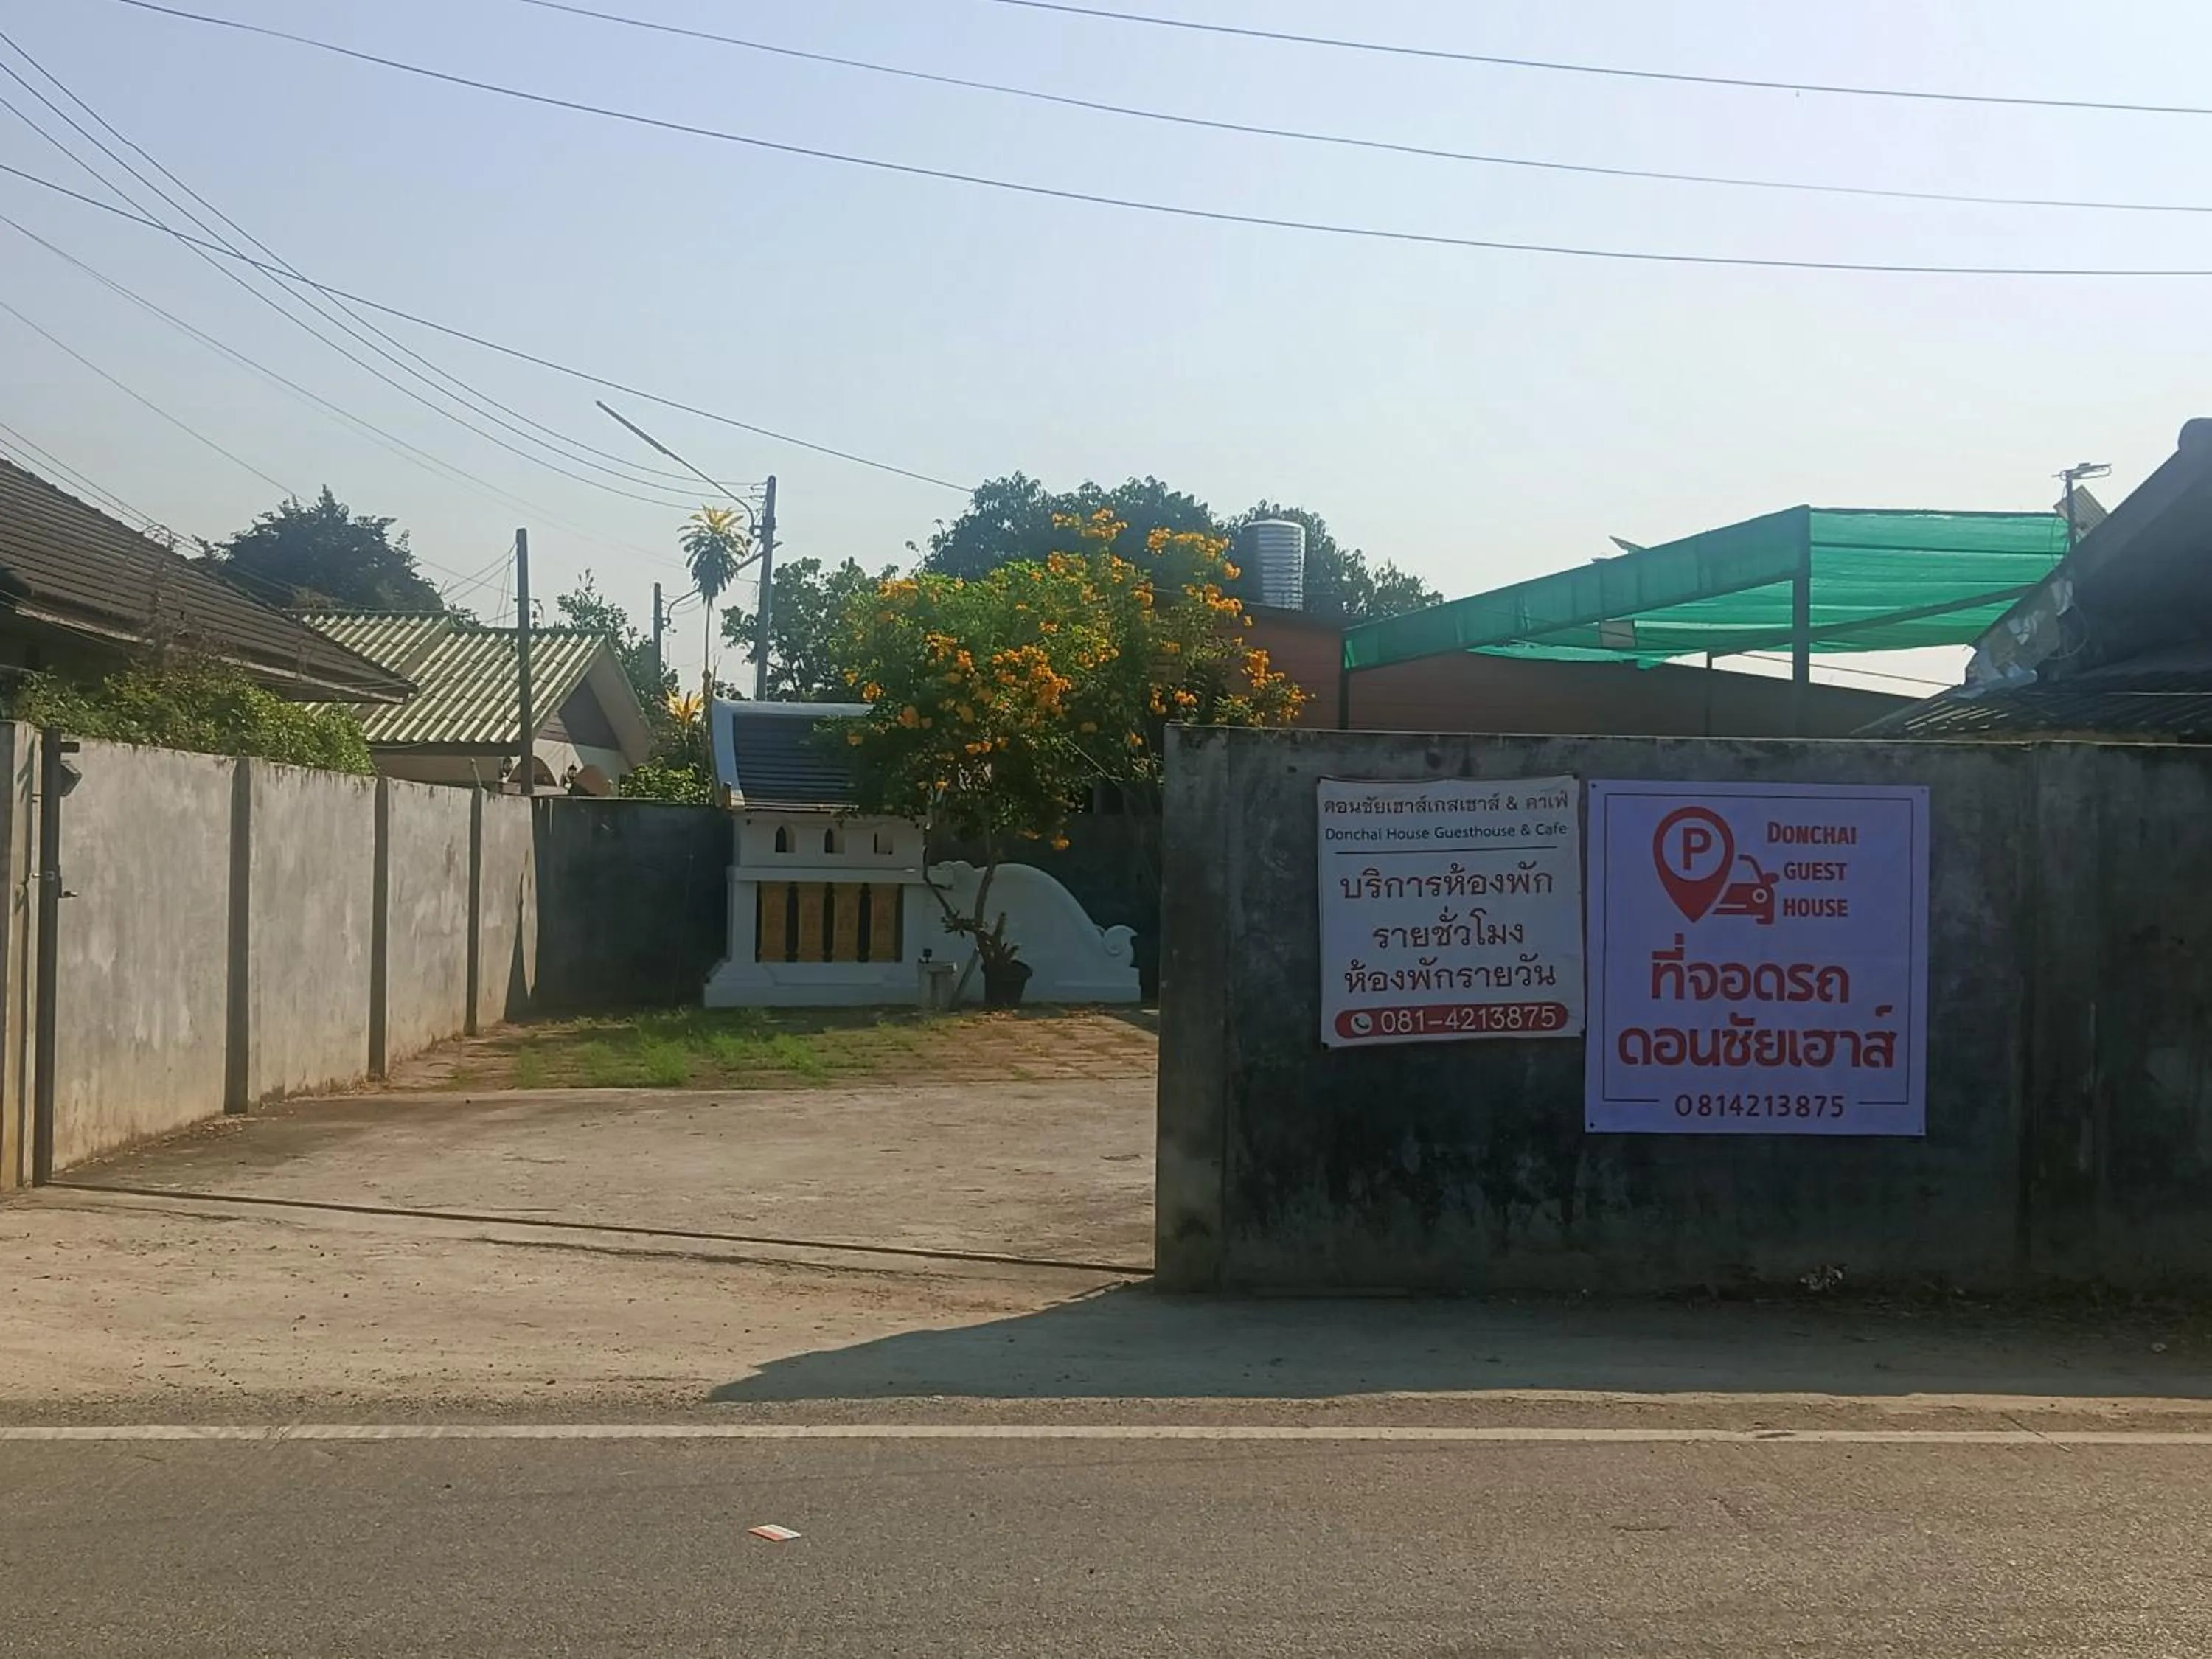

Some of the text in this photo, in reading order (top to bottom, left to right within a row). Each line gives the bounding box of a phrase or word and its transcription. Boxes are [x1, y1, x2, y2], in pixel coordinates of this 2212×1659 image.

[1506, 796, 1518, 811] &
[1326, 821, 1568, 841] Donchai House Guesthouse & Cafe
[1767, 821, 1857, 845] DONCHAI
[1682, 827, 1711, 871] P
[1340, 861, 1553, 899] บริการห้องพัก
[1784, 861, 1847, 881] GUEST
[1783, 899, 1848, 917] HOUSE
[1373, 905, 1523, 949] รายชั่วโมง
[1344, 953, 1557, 993] ห้องพักรายวัน
[1651, 933, 1850, 1004] ที่จอดรถ
[1380, 1006, 1557, 1032] 081-4213875
[1618, 1005, 1897, 1068] ดอนชัยเฮาส์
[1675, 1094, 1843, 1118] 0814213875
